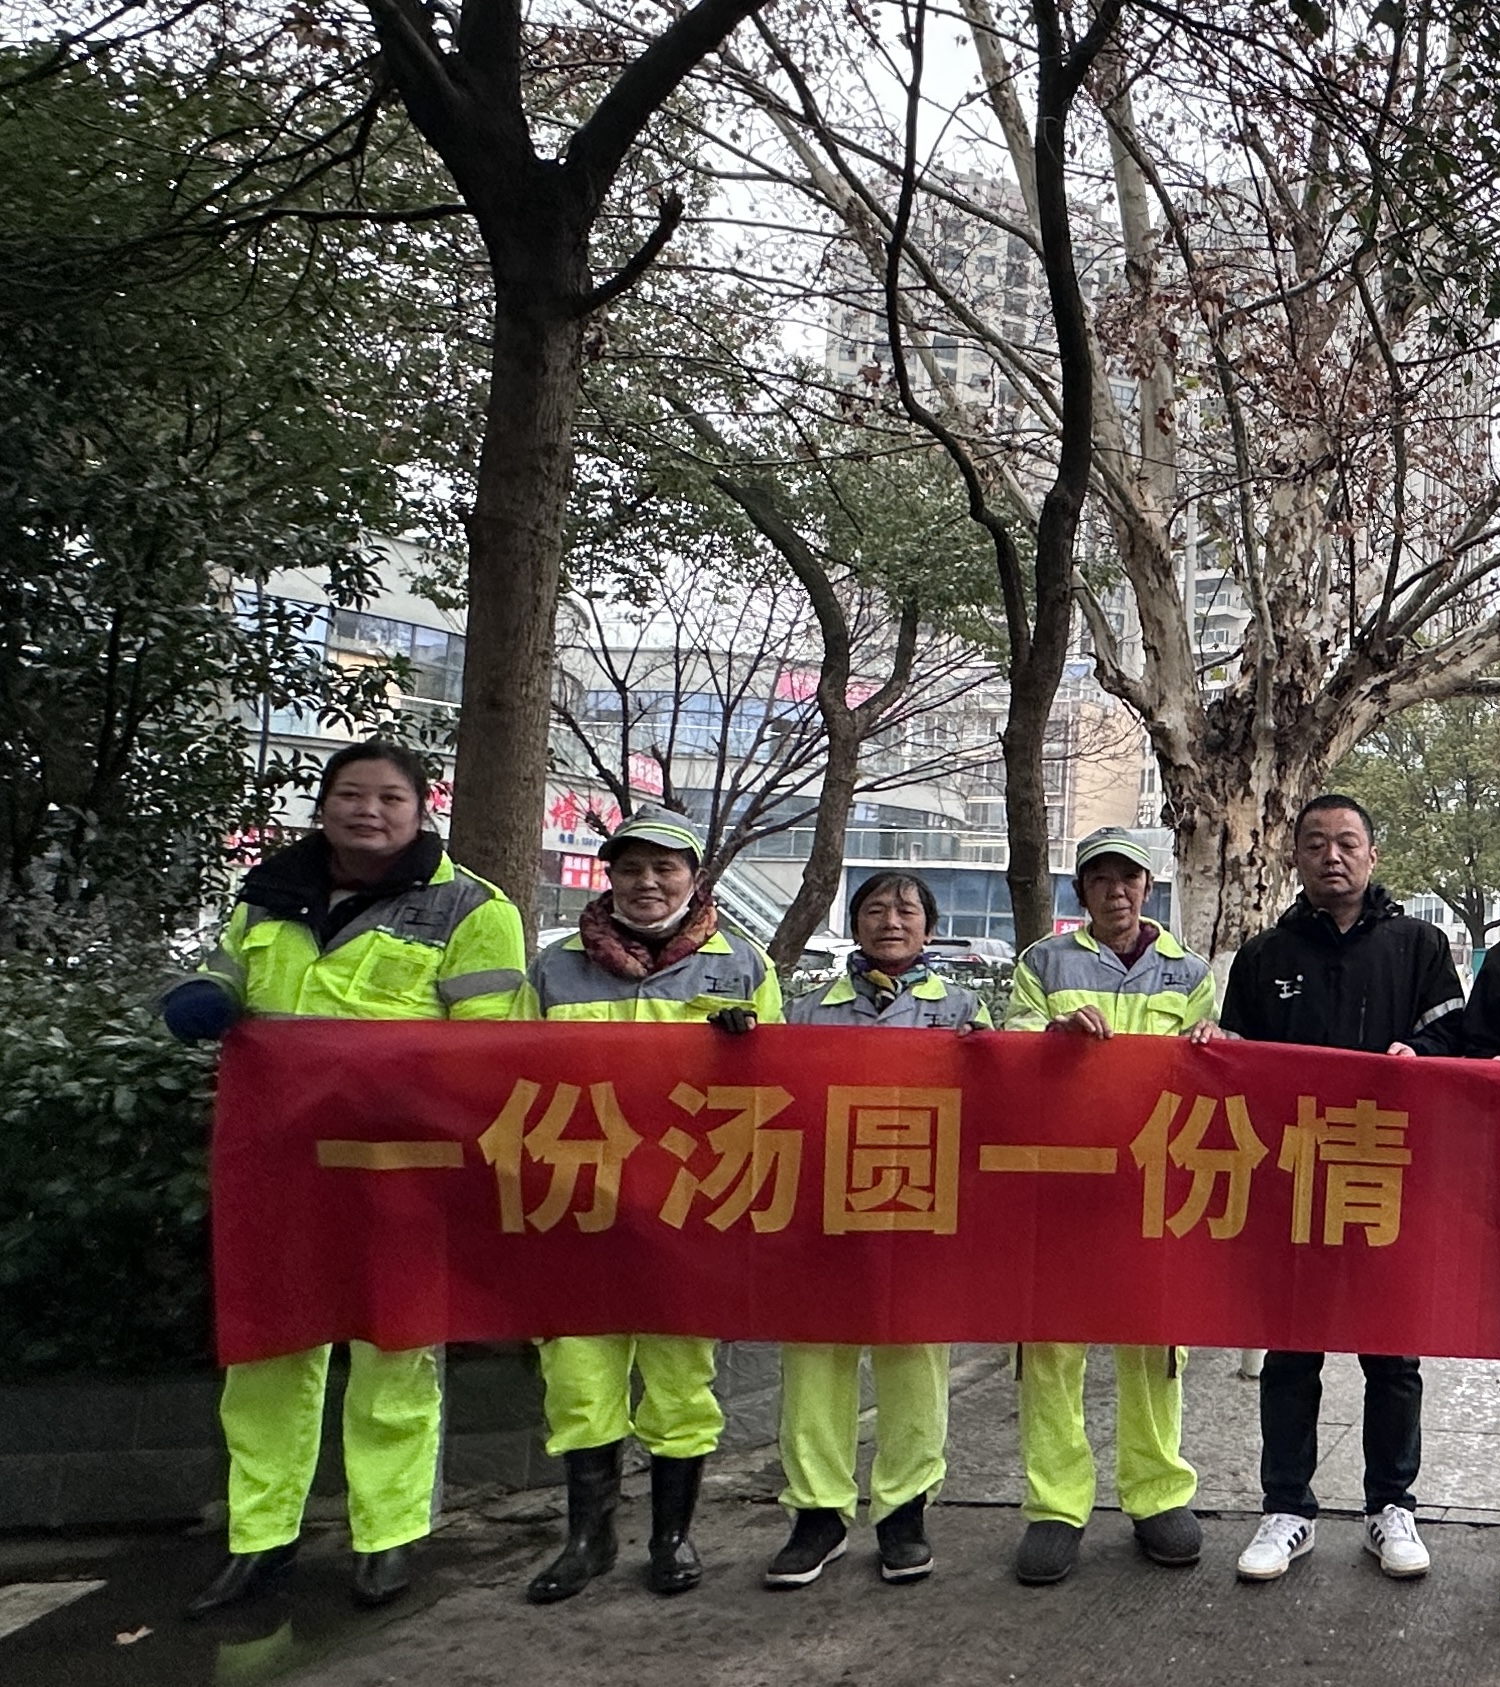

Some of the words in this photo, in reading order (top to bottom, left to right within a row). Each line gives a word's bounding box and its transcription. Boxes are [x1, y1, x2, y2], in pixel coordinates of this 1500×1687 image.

[316, 1080, 1412, 1247] 一份汤圆一份情
